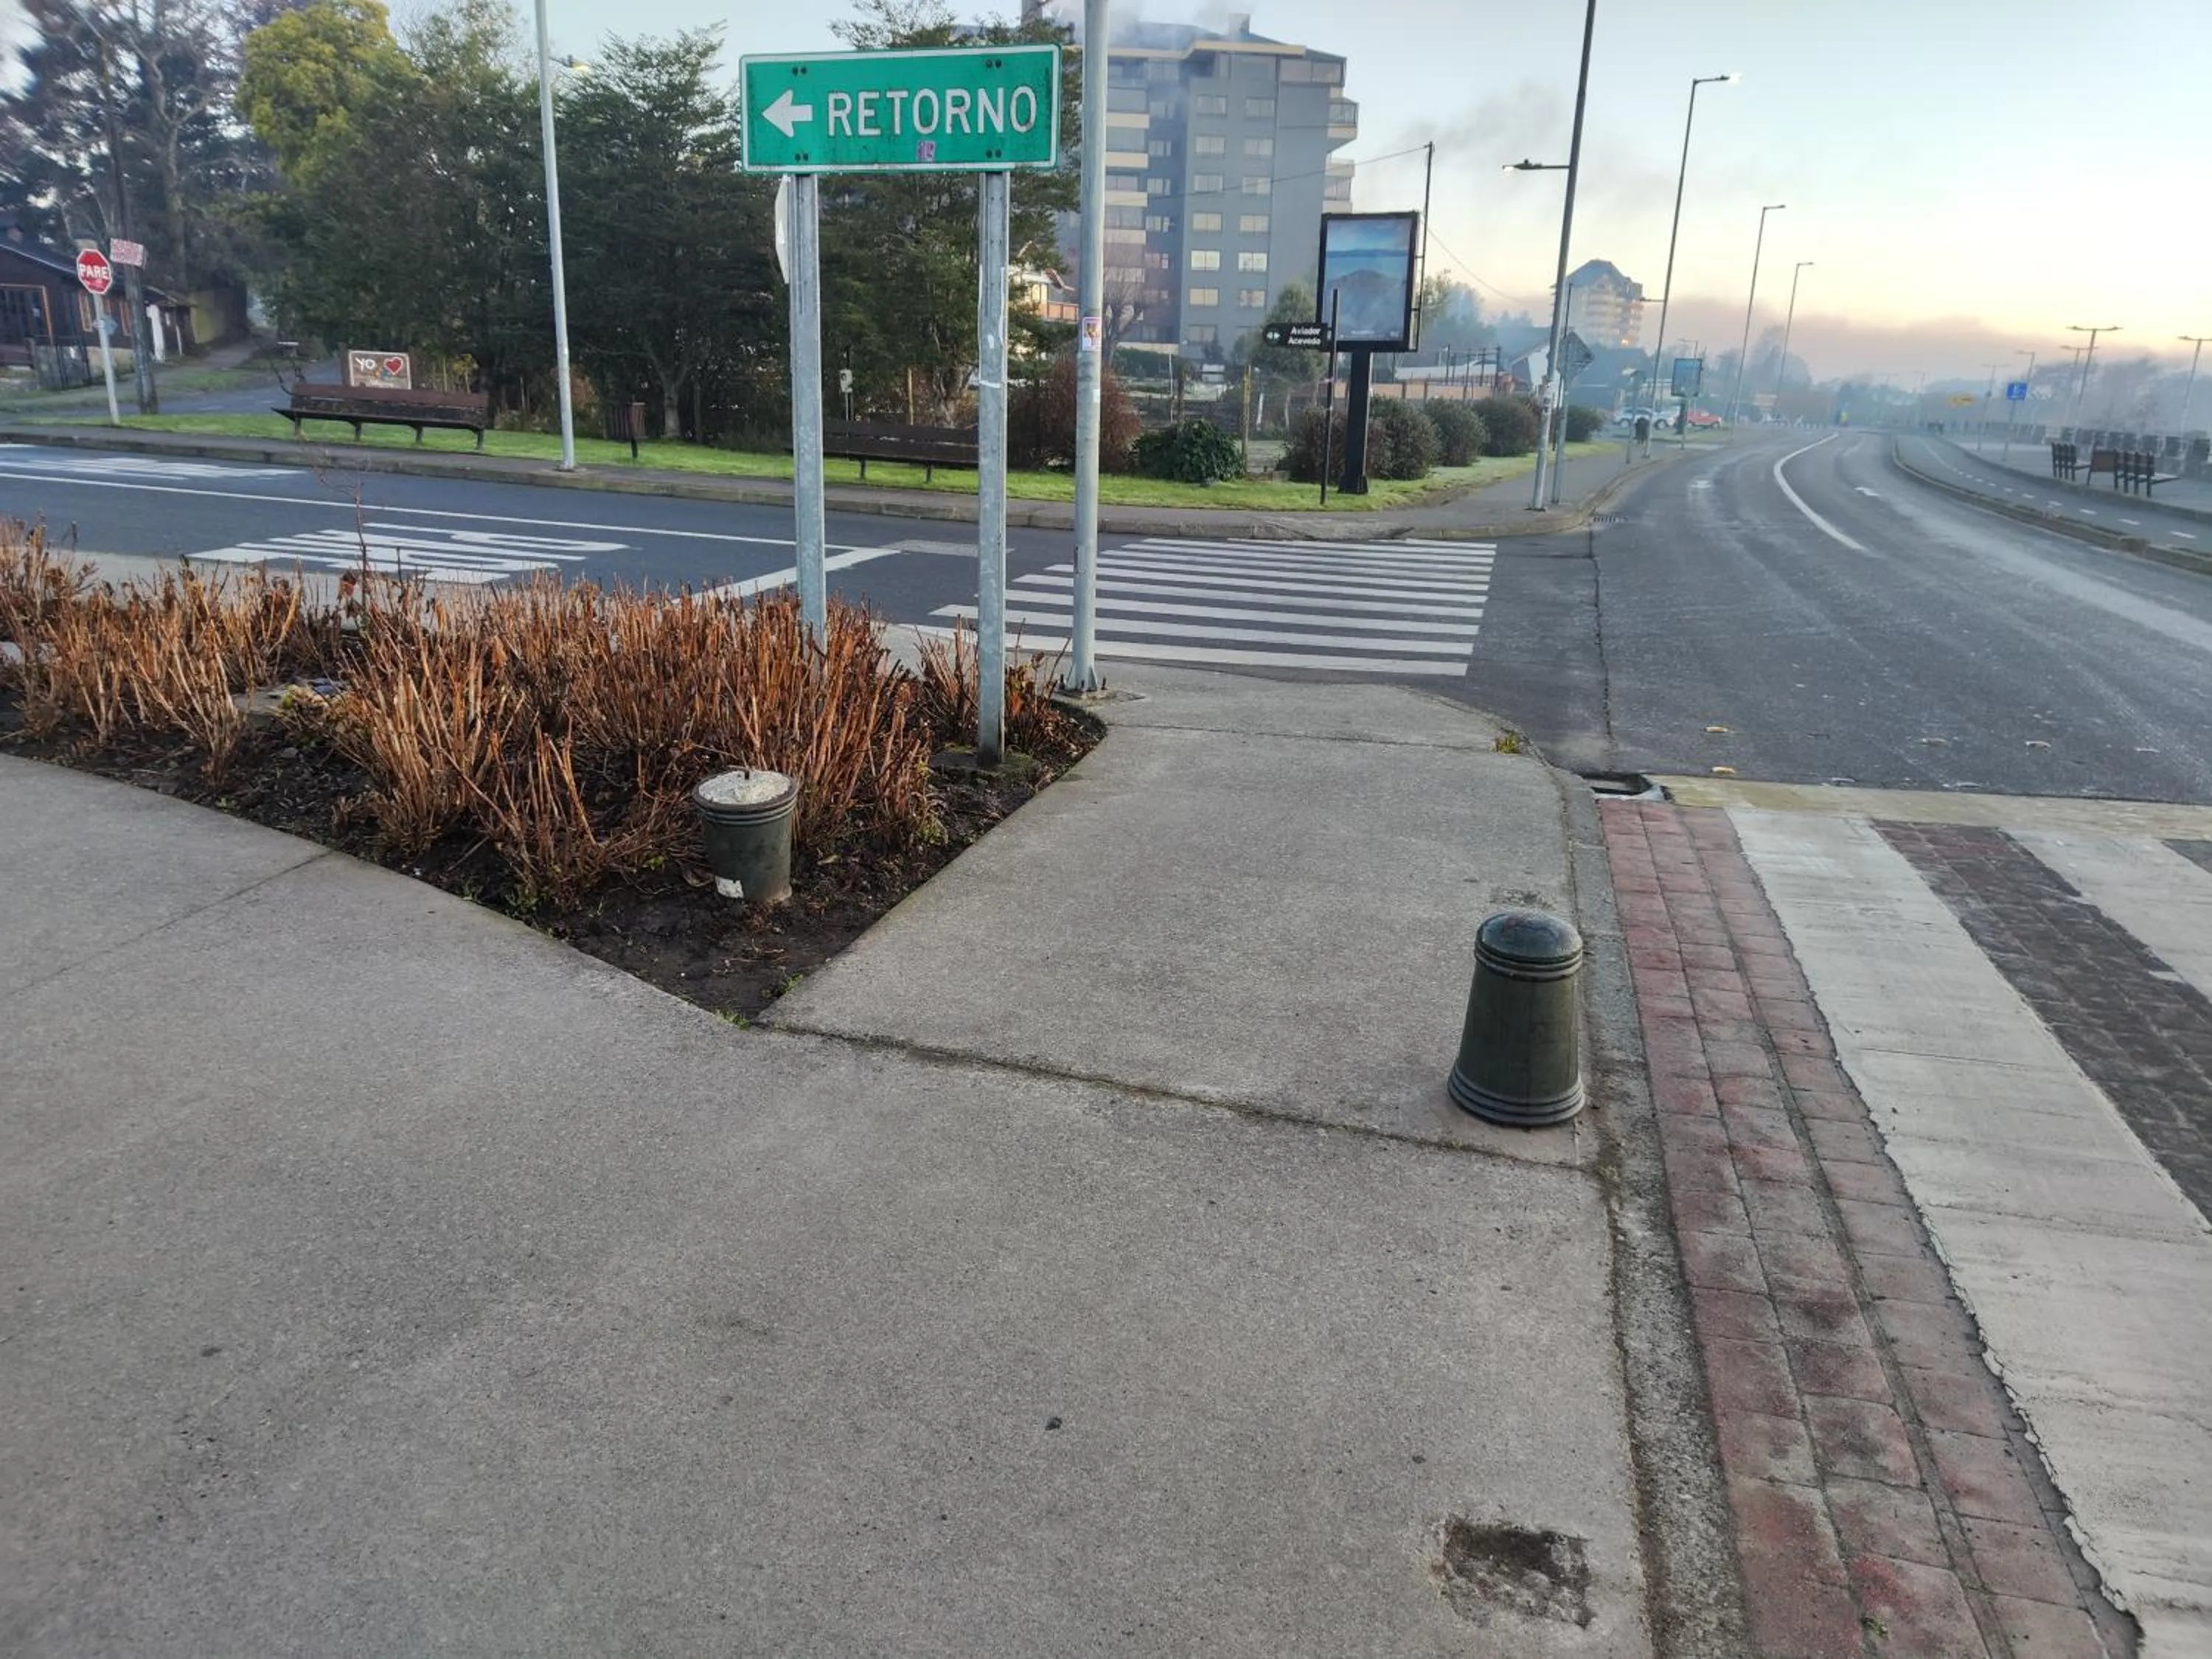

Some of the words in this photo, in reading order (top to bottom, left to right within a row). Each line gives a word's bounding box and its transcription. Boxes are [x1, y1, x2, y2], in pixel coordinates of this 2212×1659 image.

[827, 85, 1037, 137] RETORNO
[78, 262, 110, 280] PARE
[1290, 325, 1321, 335] Aviador
[1287, 336, 1321, 345] Acevedo
